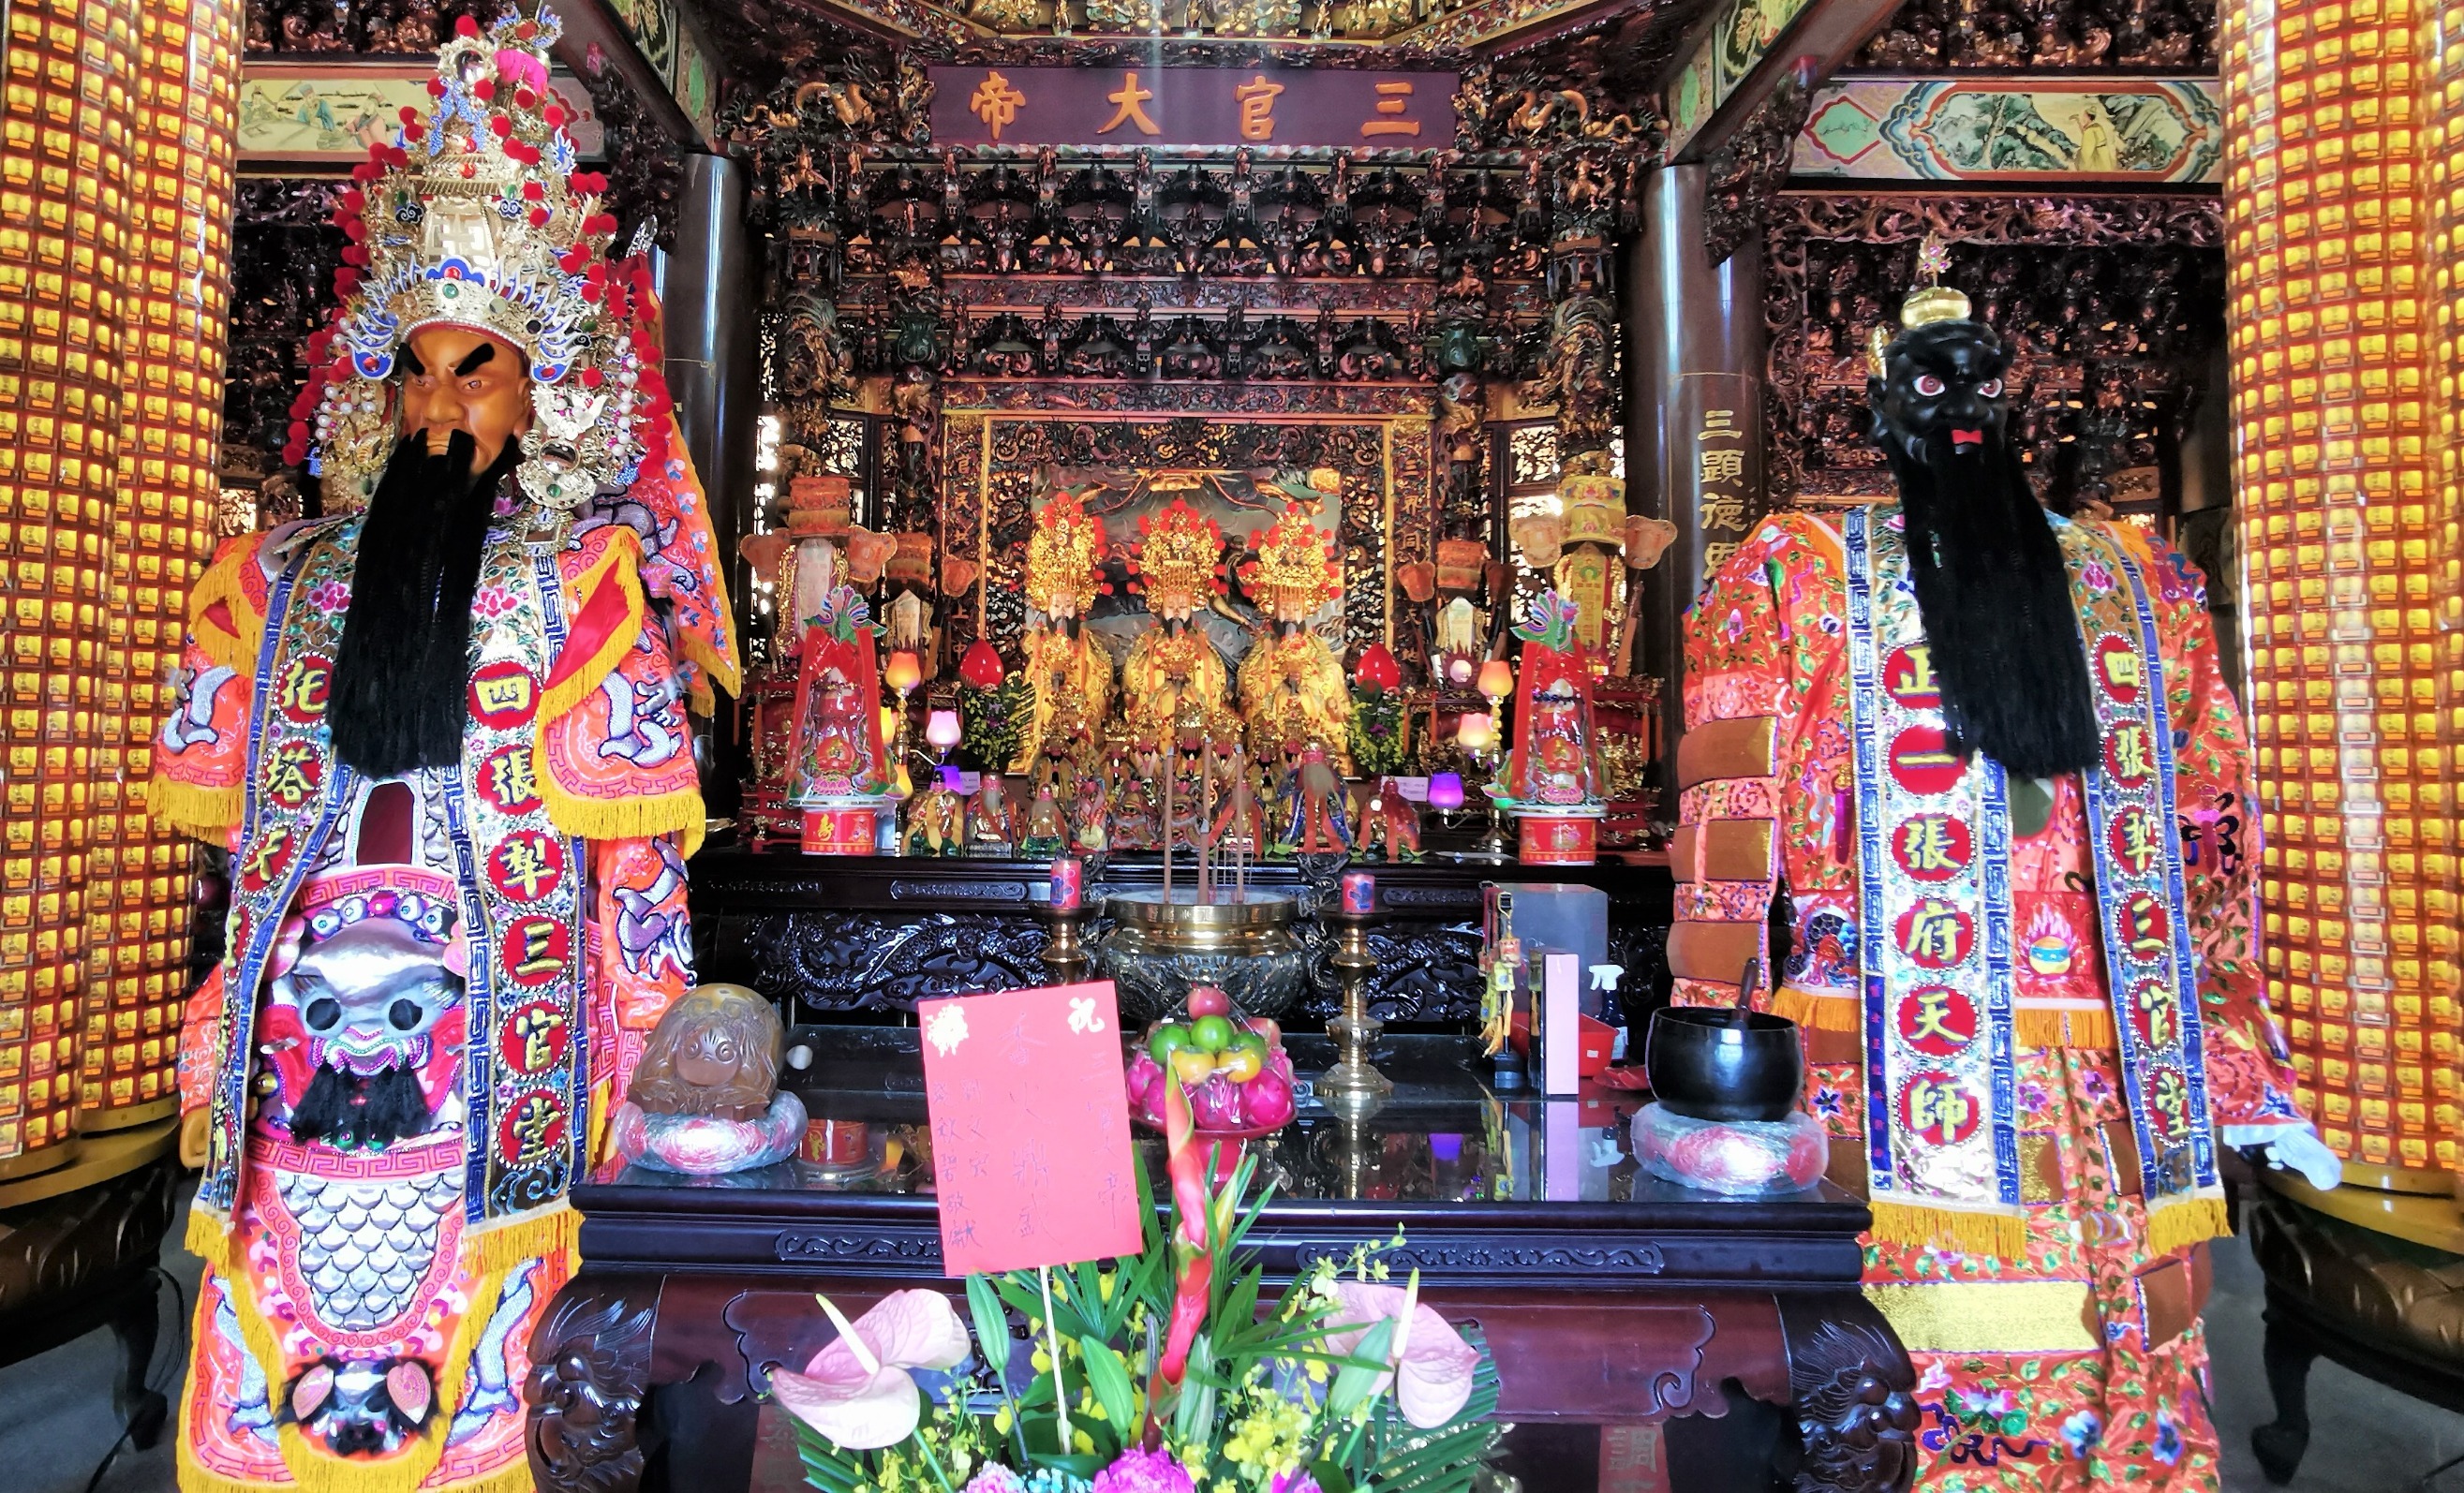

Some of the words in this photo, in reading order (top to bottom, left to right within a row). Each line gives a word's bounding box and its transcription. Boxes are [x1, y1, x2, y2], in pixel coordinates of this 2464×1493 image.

[969, 70, 1421, 140] 三官大帝
[1893, 646, 1969, 1142] 正一張府天師
